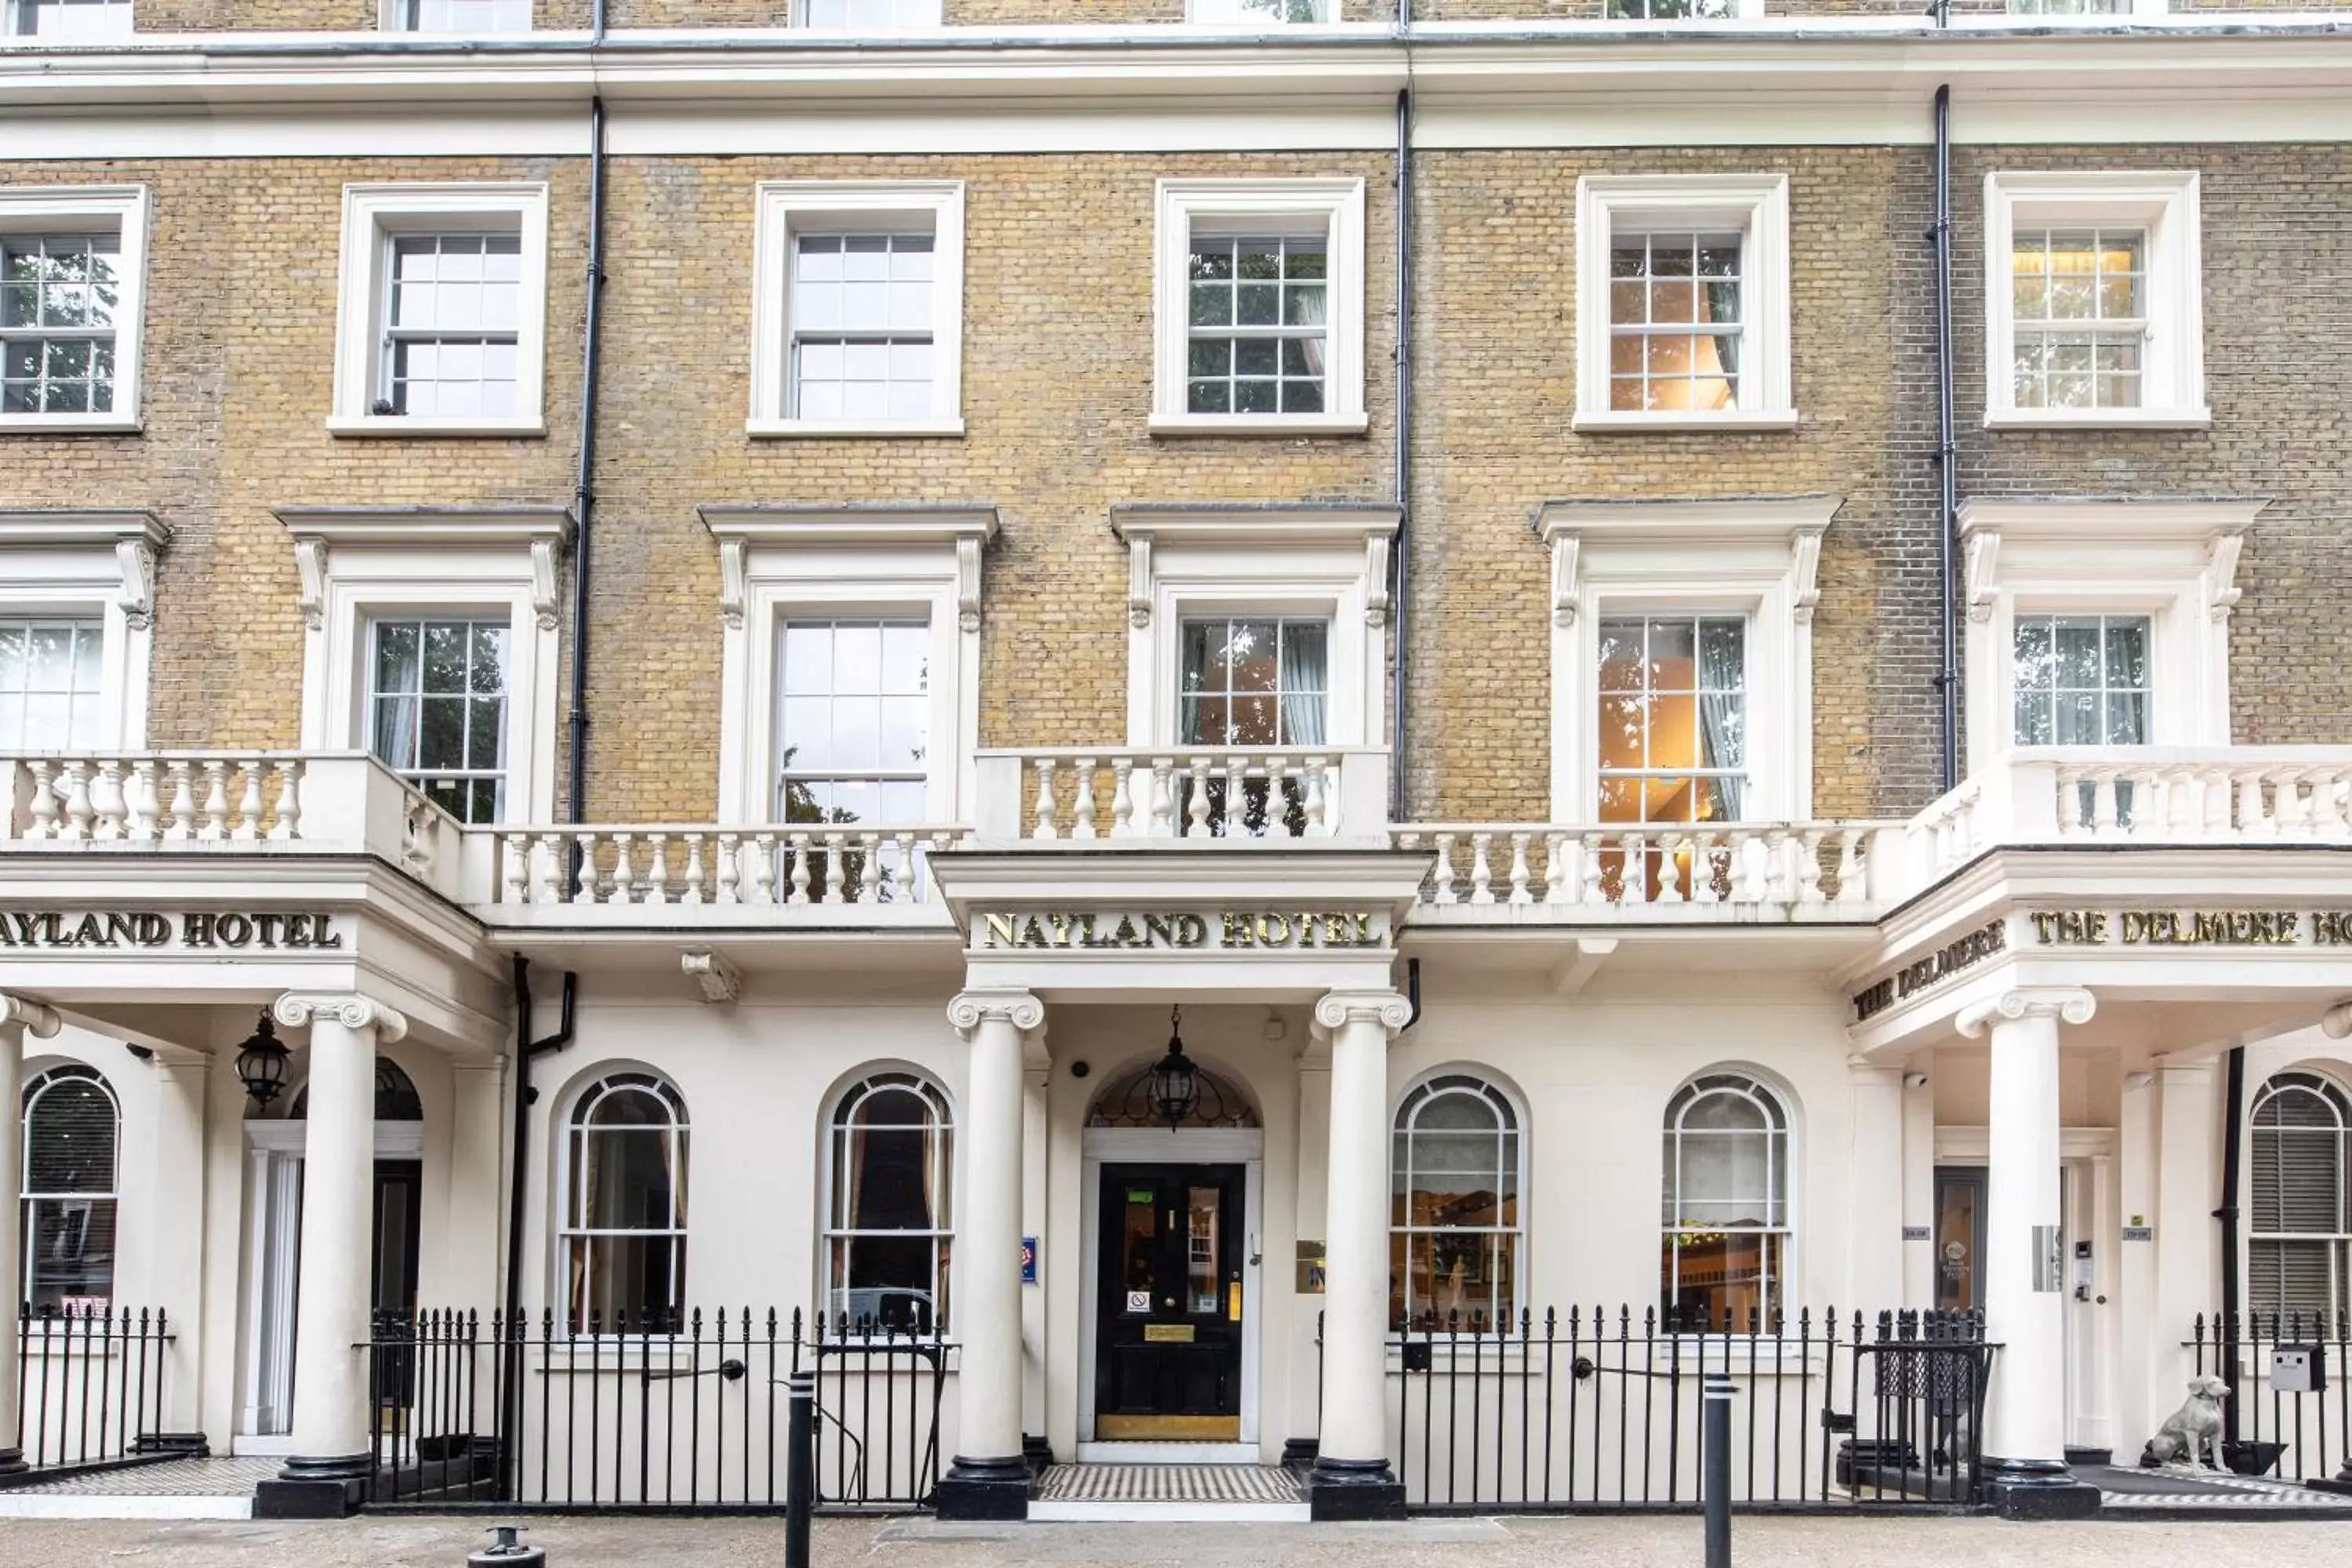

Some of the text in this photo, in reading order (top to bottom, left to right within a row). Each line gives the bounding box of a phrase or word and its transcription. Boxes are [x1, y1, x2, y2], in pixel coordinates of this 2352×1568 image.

[181, 913, 342, 947] HOTEL
[982, 912, 1382, 948] NAYLAND HOTEL
[2031, 911, 2109, 946] THE
[2121, 911, 2302, 946] DELMERE
[1853, 918, 2006, 1021] THE DELMERE
